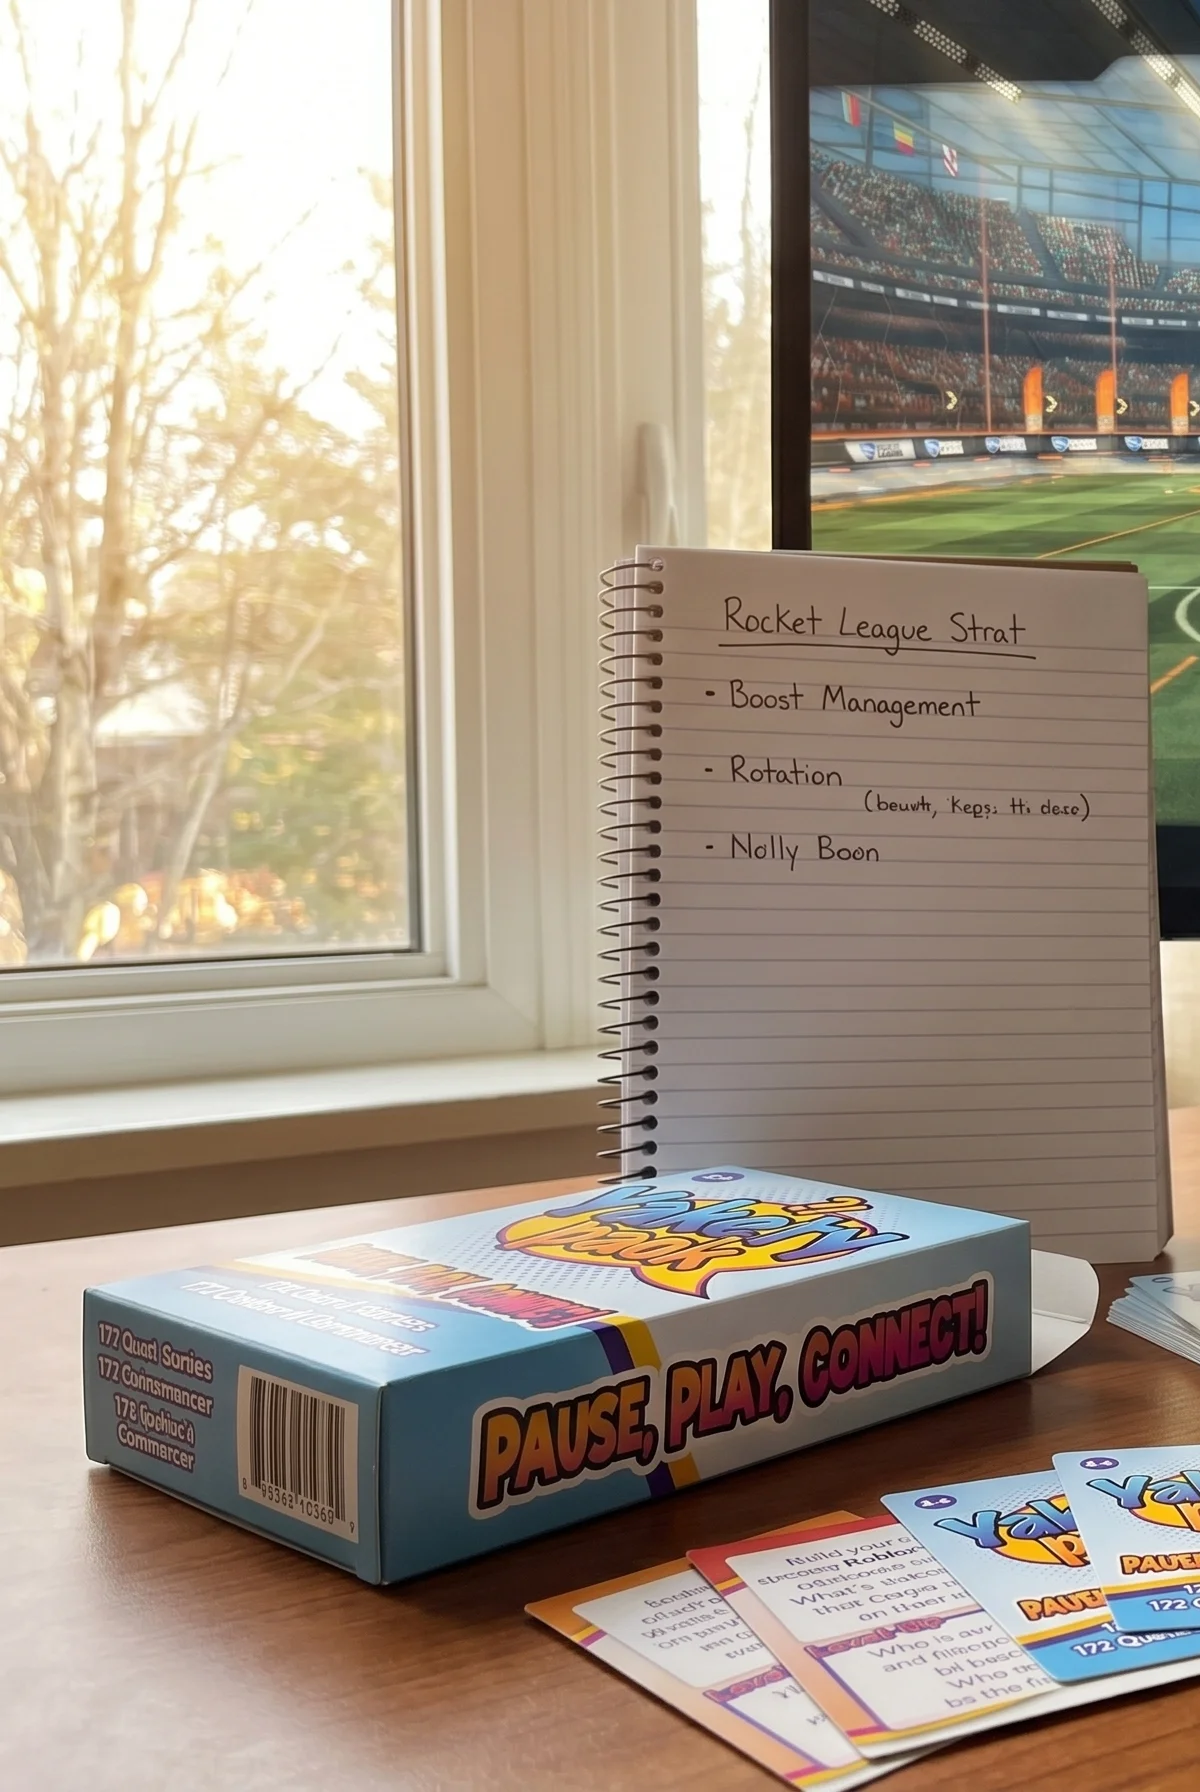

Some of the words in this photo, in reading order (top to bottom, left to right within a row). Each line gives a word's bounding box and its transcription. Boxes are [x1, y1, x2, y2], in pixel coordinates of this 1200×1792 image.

[724, 596, 823, 636] Rocket
[840, 607, 933, 656] League
[950, 612, 1027, 645] Strat
[729, 680, 804, 711] Boost
[822, 685, 981, 728] Management
[730, 755, 843, 787] Rotation
[730, 834, 799, 871] Nolly
[818, 836, 880, 863] Boon
[476, 1372, 660, 1510] PAUSE,
[665, 1340, 793, 1453] PLAY,
[800, 1279, 988, 1408] CONNECT!
[846, 1539, 893, 1557] your
[790, 1584, 873, 1606] What's
[1150, 1598, 1188, 1612] 172
[859, 1609, 887, 1622] on
[868, 1640, 929, 1659] Who
[1073, 1641, 1114, 1657] 172
[883, 1655, 928, 1673] and
[945, 1670, 1007, 1690] Who
[981, 1681, 1022, 1696] the
